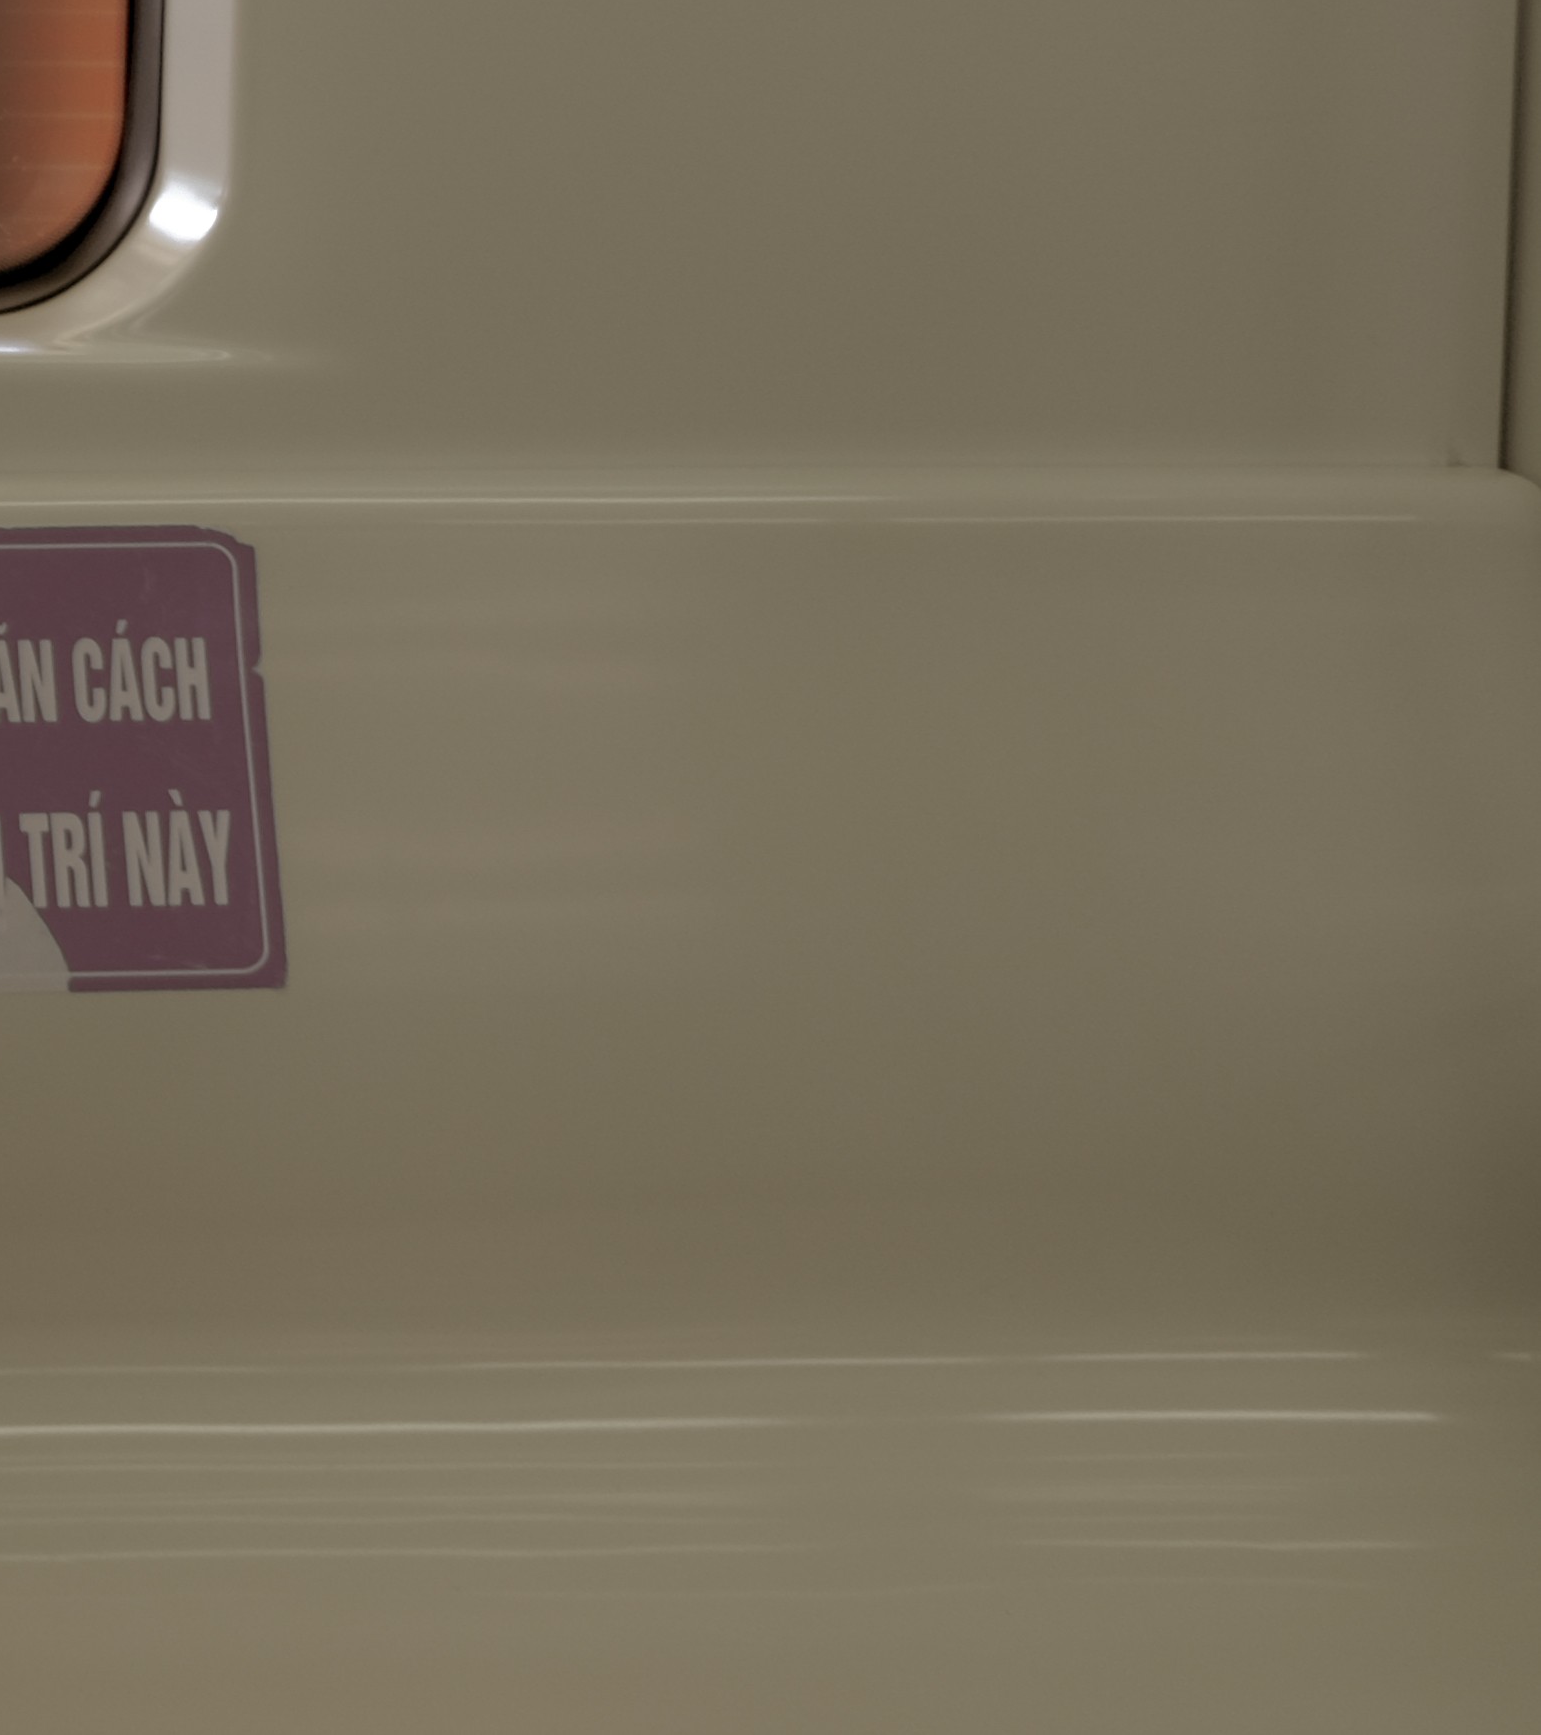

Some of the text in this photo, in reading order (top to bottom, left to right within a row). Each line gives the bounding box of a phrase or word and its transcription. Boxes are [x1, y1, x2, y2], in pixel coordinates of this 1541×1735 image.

[73, 620, 212, 723] CÁCH
[20, 792, 110, 908] TRÍ
[123, 790, 231, 906] NÀY
